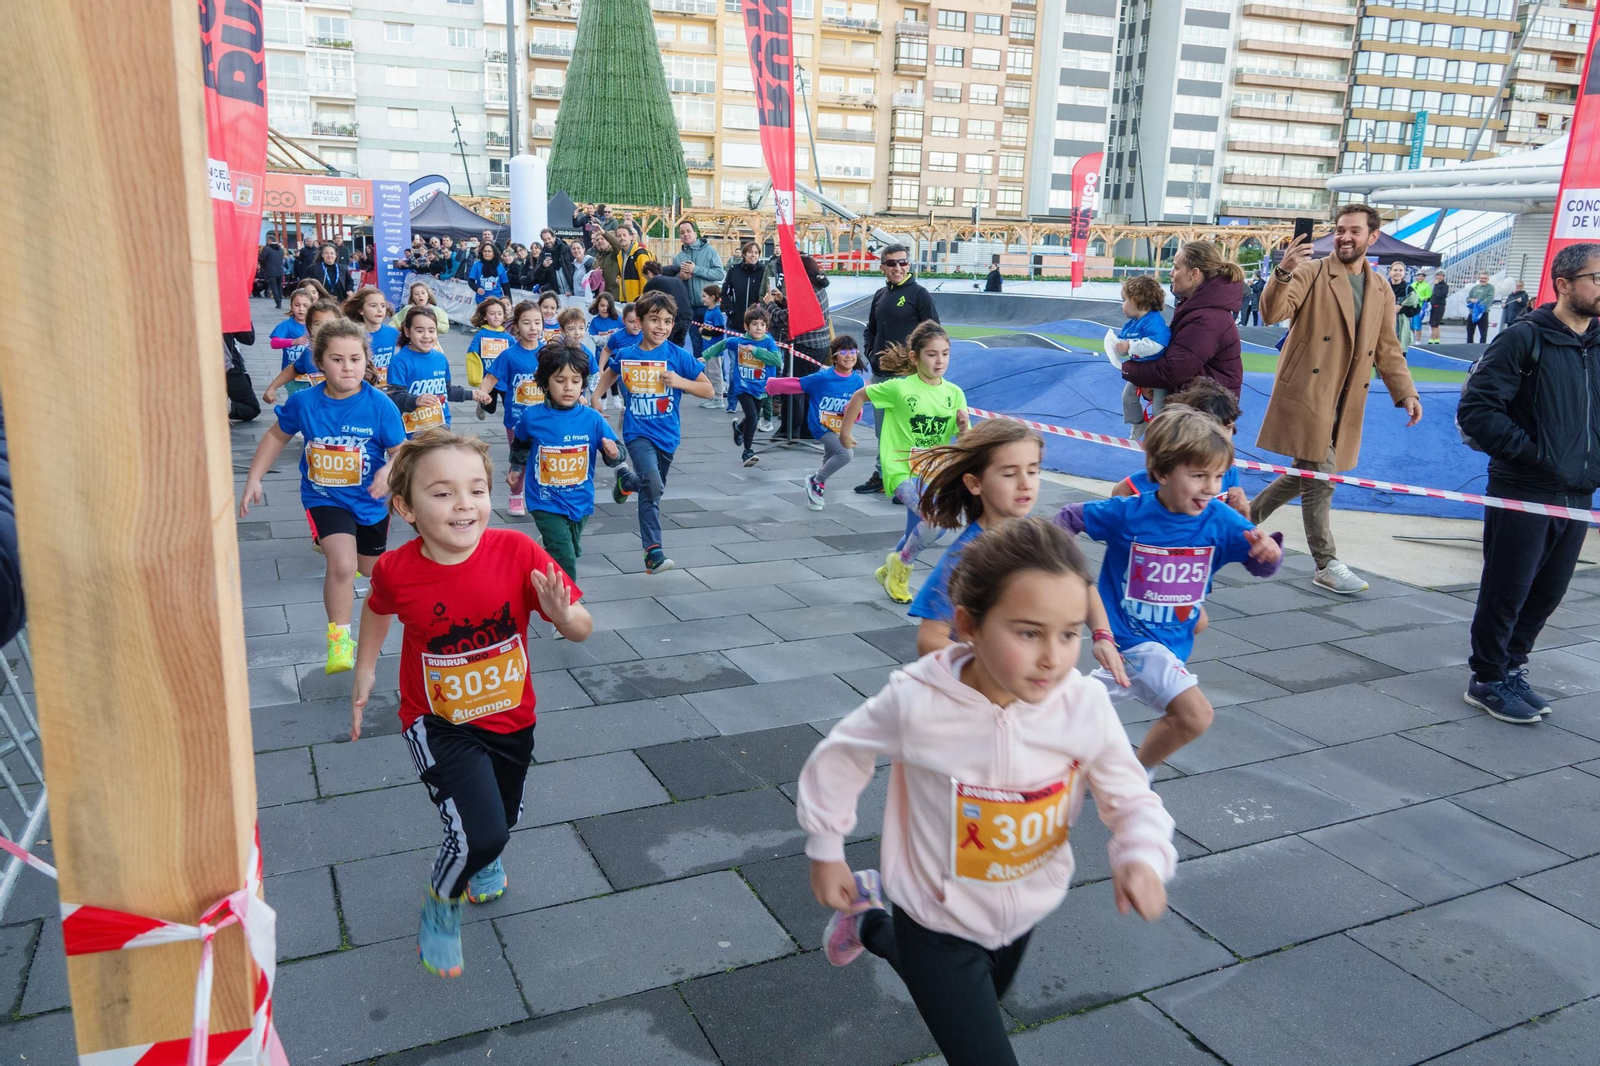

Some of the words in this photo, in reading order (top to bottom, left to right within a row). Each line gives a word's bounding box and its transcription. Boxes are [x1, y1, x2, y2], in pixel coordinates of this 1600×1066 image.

[1572, 216, 1590, 227] DE
[632, 370, 660, 382] 3021
[412, 405, 440, 422] 3006
[313, 453, 355, 472] 3003
[548, 456, 586, 473] 3029
[1146, 562, 1205, 583] 2025
[1143, 589, 1193, 604] Alcampo
[444, 658, 520, 700] 3034
[452, 698, 511, 721] Alcampo
